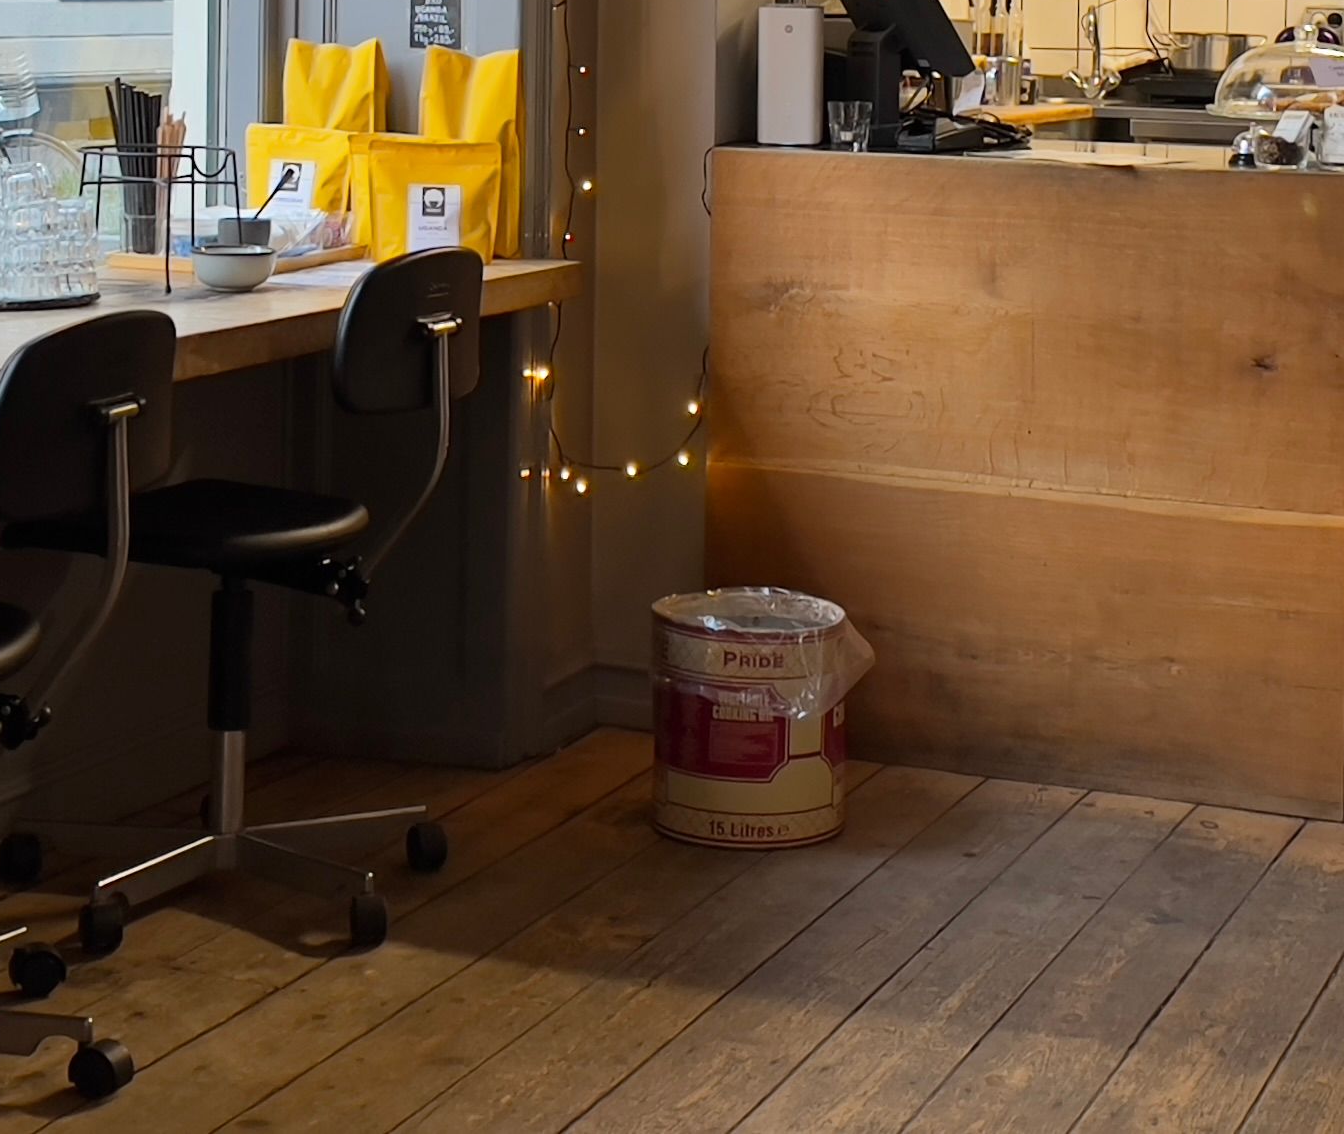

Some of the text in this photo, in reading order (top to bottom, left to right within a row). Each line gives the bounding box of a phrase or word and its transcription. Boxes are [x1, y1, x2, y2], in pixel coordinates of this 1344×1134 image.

[724, 650, 784, 668] PRIDE
[709, 821, 773, 838] 15 Litres
